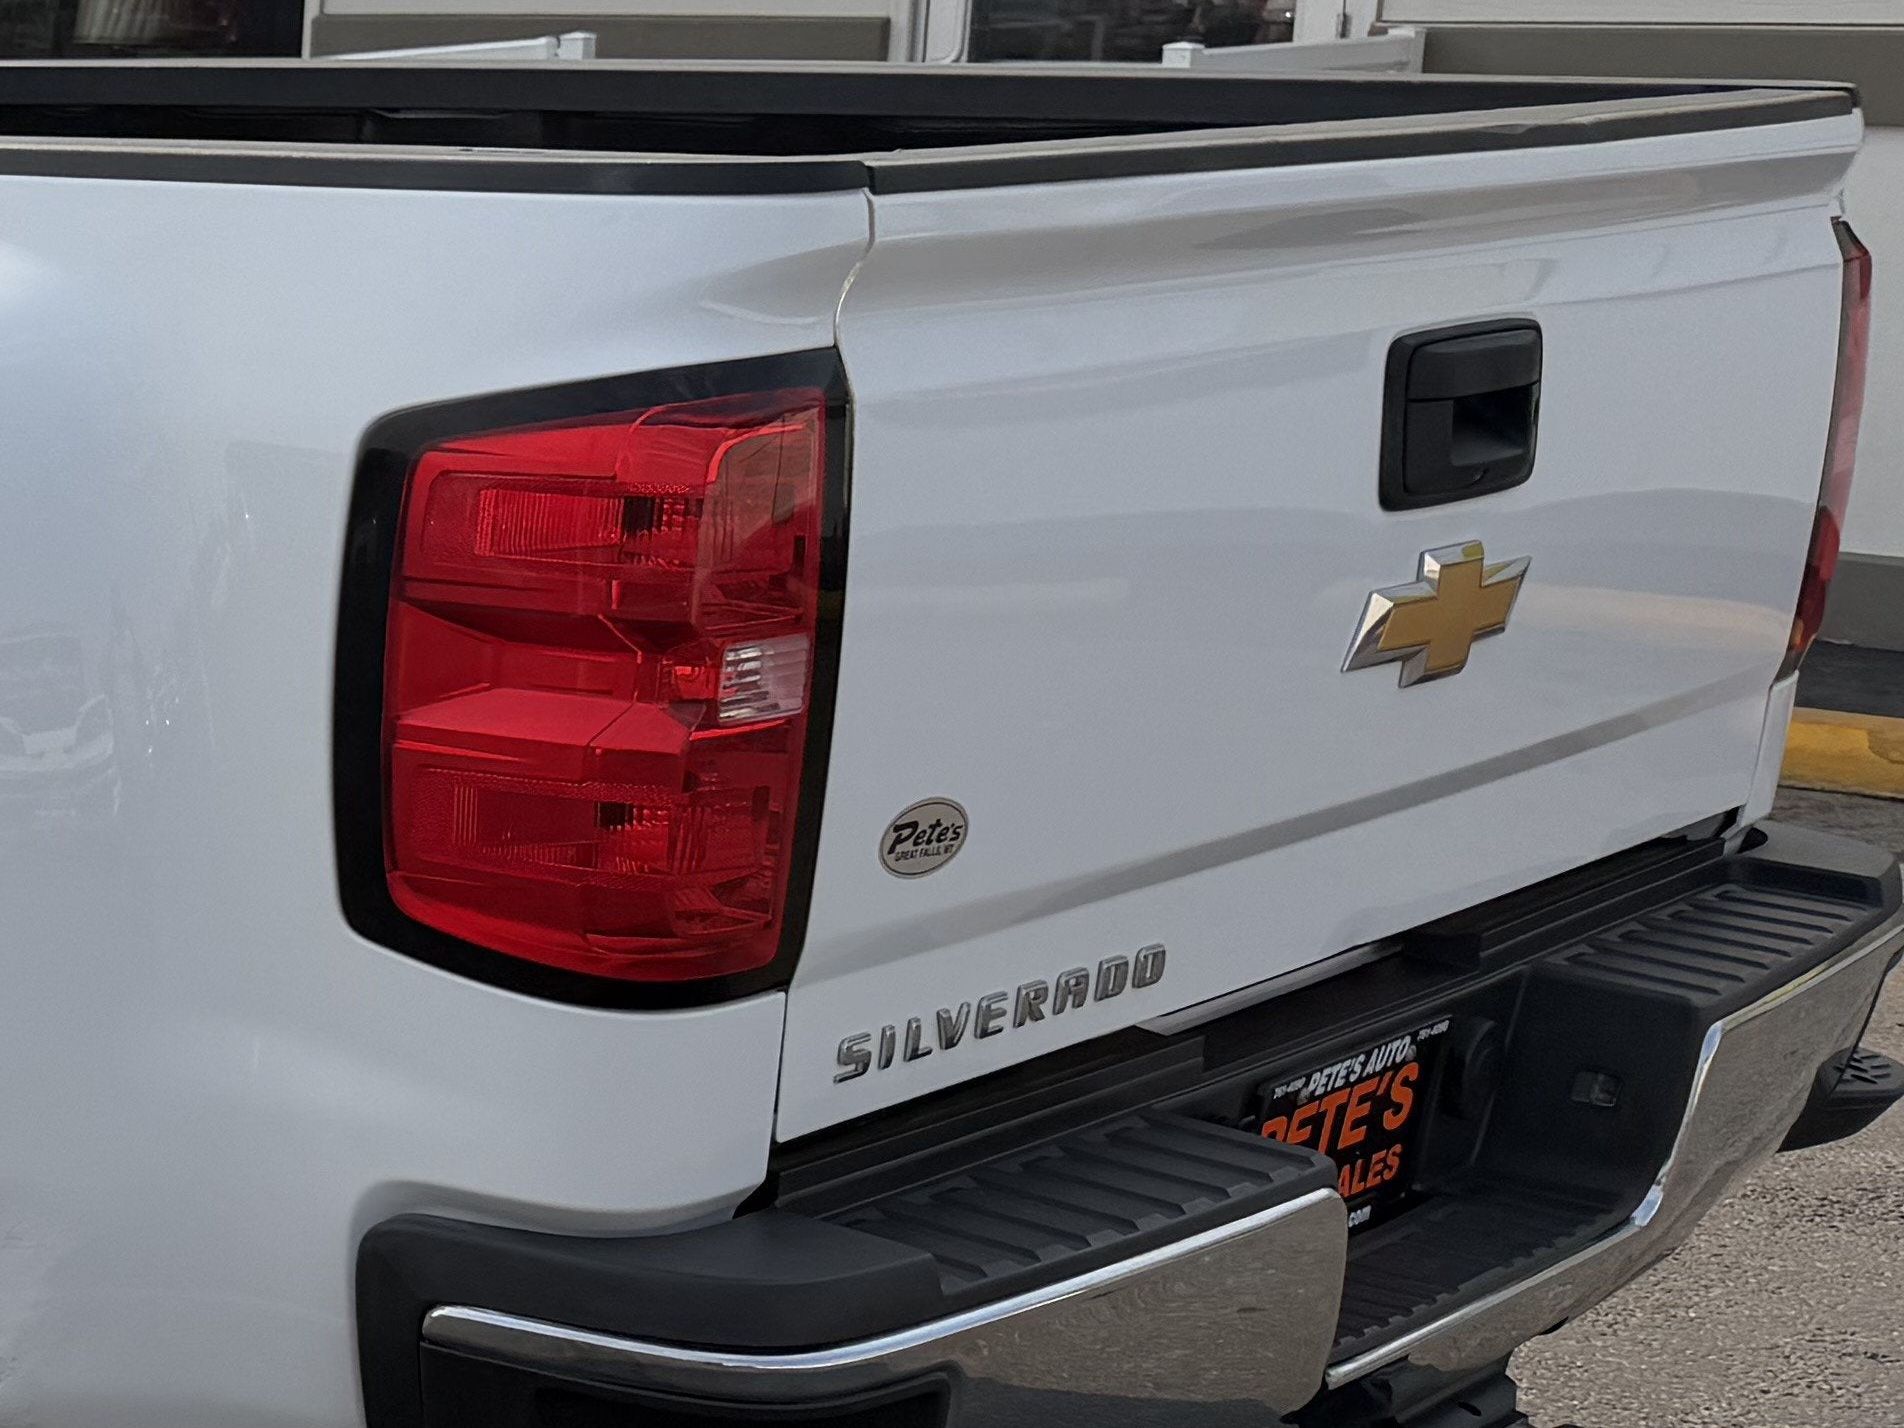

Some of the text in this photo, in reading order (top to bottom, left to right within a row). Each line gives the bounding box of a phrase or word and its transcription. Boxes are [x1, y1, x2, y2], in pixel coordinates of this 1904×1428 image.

[887, 818, 964, 855] Pete's
[833, 942, 1168, 1084] SILVERADO
[1307, 1035, 1412, 1097] PETE'S AUTO
[1338, 1144, 1403, 1198] ALES
